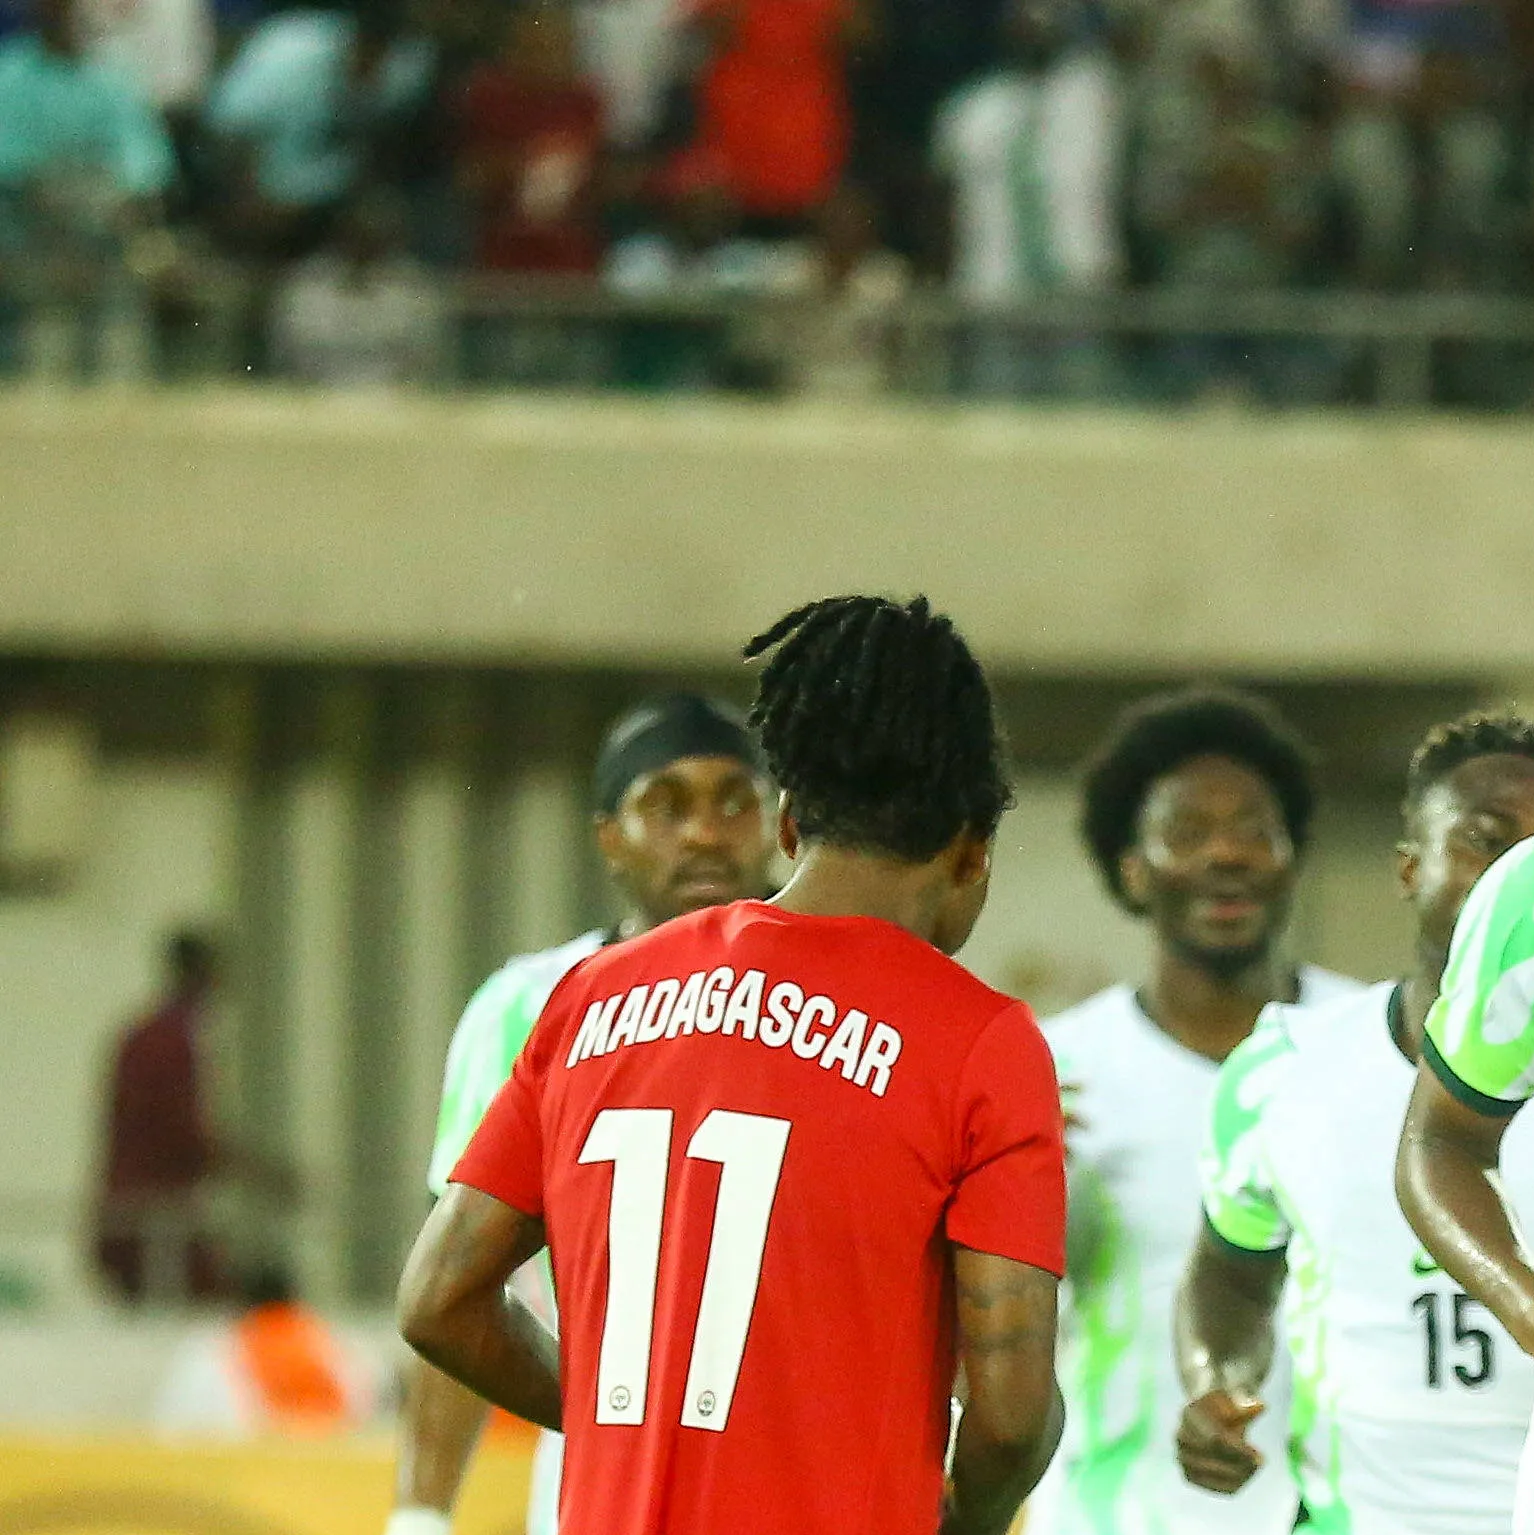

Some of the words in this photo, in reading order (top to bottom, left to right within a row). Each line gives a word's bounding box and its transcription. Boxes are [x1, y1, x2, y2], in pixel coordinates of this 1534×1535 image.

[564, 965, 904, 1097] MADAGASCAR
[576, 1106, 793, 1432] 11
[1412, 1292, 1495, 1388] 15
